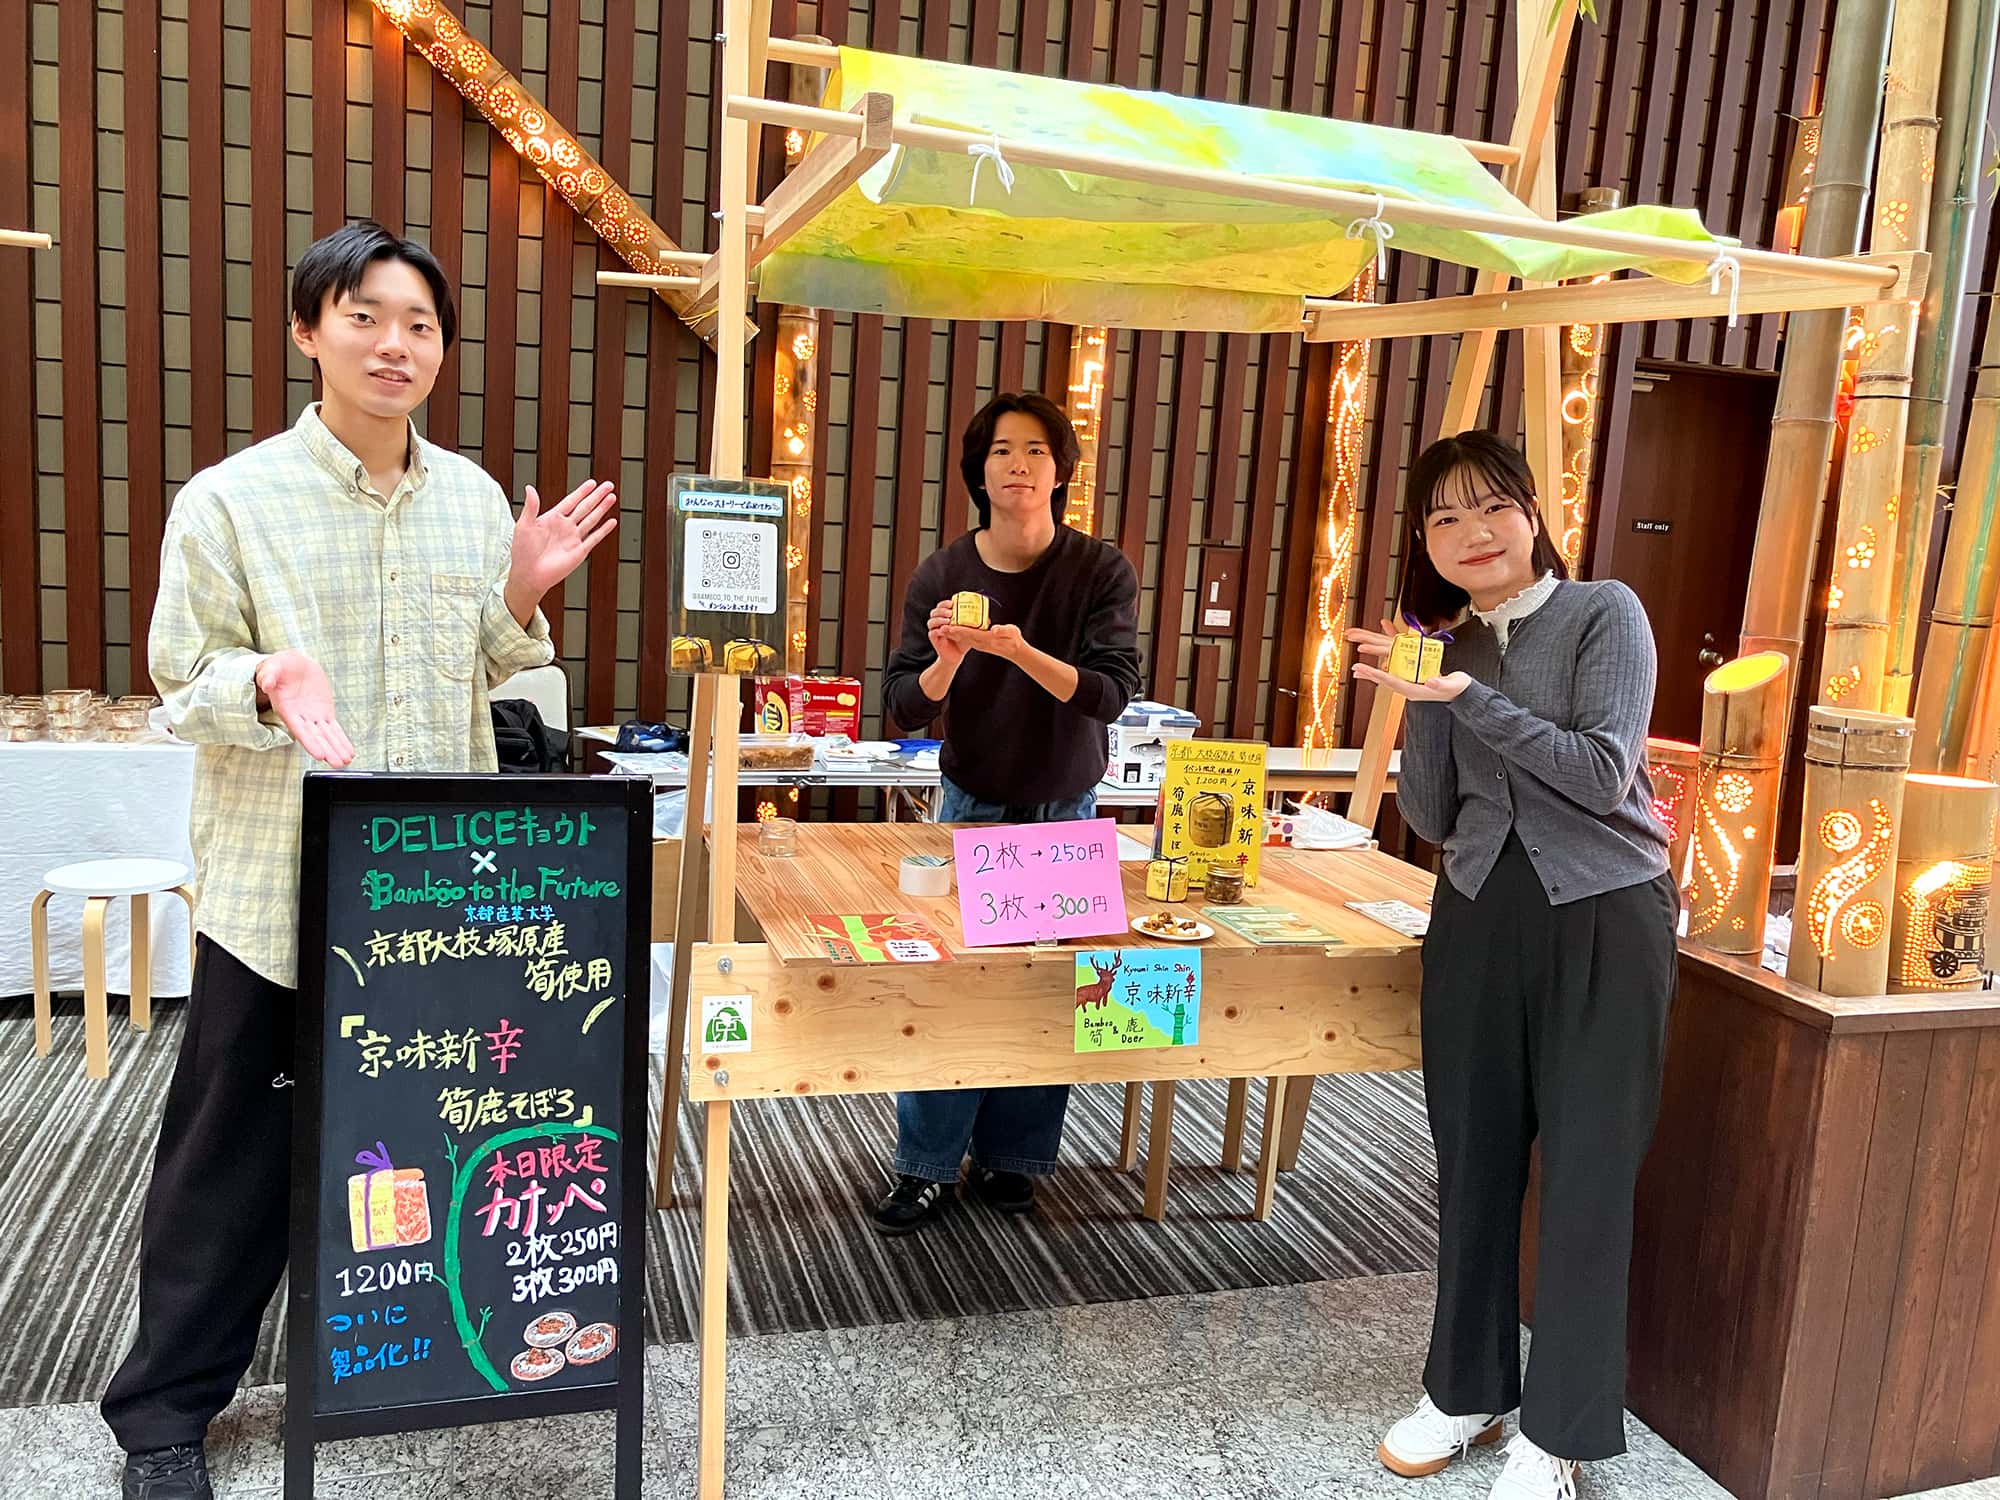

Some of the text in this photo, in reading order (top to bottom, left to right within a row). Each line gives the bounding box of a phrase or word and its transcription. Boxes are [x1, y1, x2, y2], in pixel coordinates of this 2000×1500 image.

[1636, 522, 1669, 531] Staff only
[1236, 778, 1257, 866] 京味新辛
[973, 840, 1104, 875] 2枚 250円
[366, 866, 621, 911] Bamboo to the Future
[464, 904, 556, 923] 京都産業大学
[979, 892, 1108, 925] 3枚 300円
[364, 921, 569, 968] 京都大枝塚原産
[524, 958, 612, 1001] 筍使用
[1153, 963, 1169, 973] Shin
[1124, 981, 1196, 1006] 京味新辛
[1084, 1017, 1113, 1029] Bamboo
[1125, 1016, 1144, 1033] 鹿
[485, 1133, 609, 1188] 本日限定
[474, 1178, 608, 1236] カナッペ
[335, 1260, 434, 1297] 1200円
[326, 1304, 408, 1331] ついに
